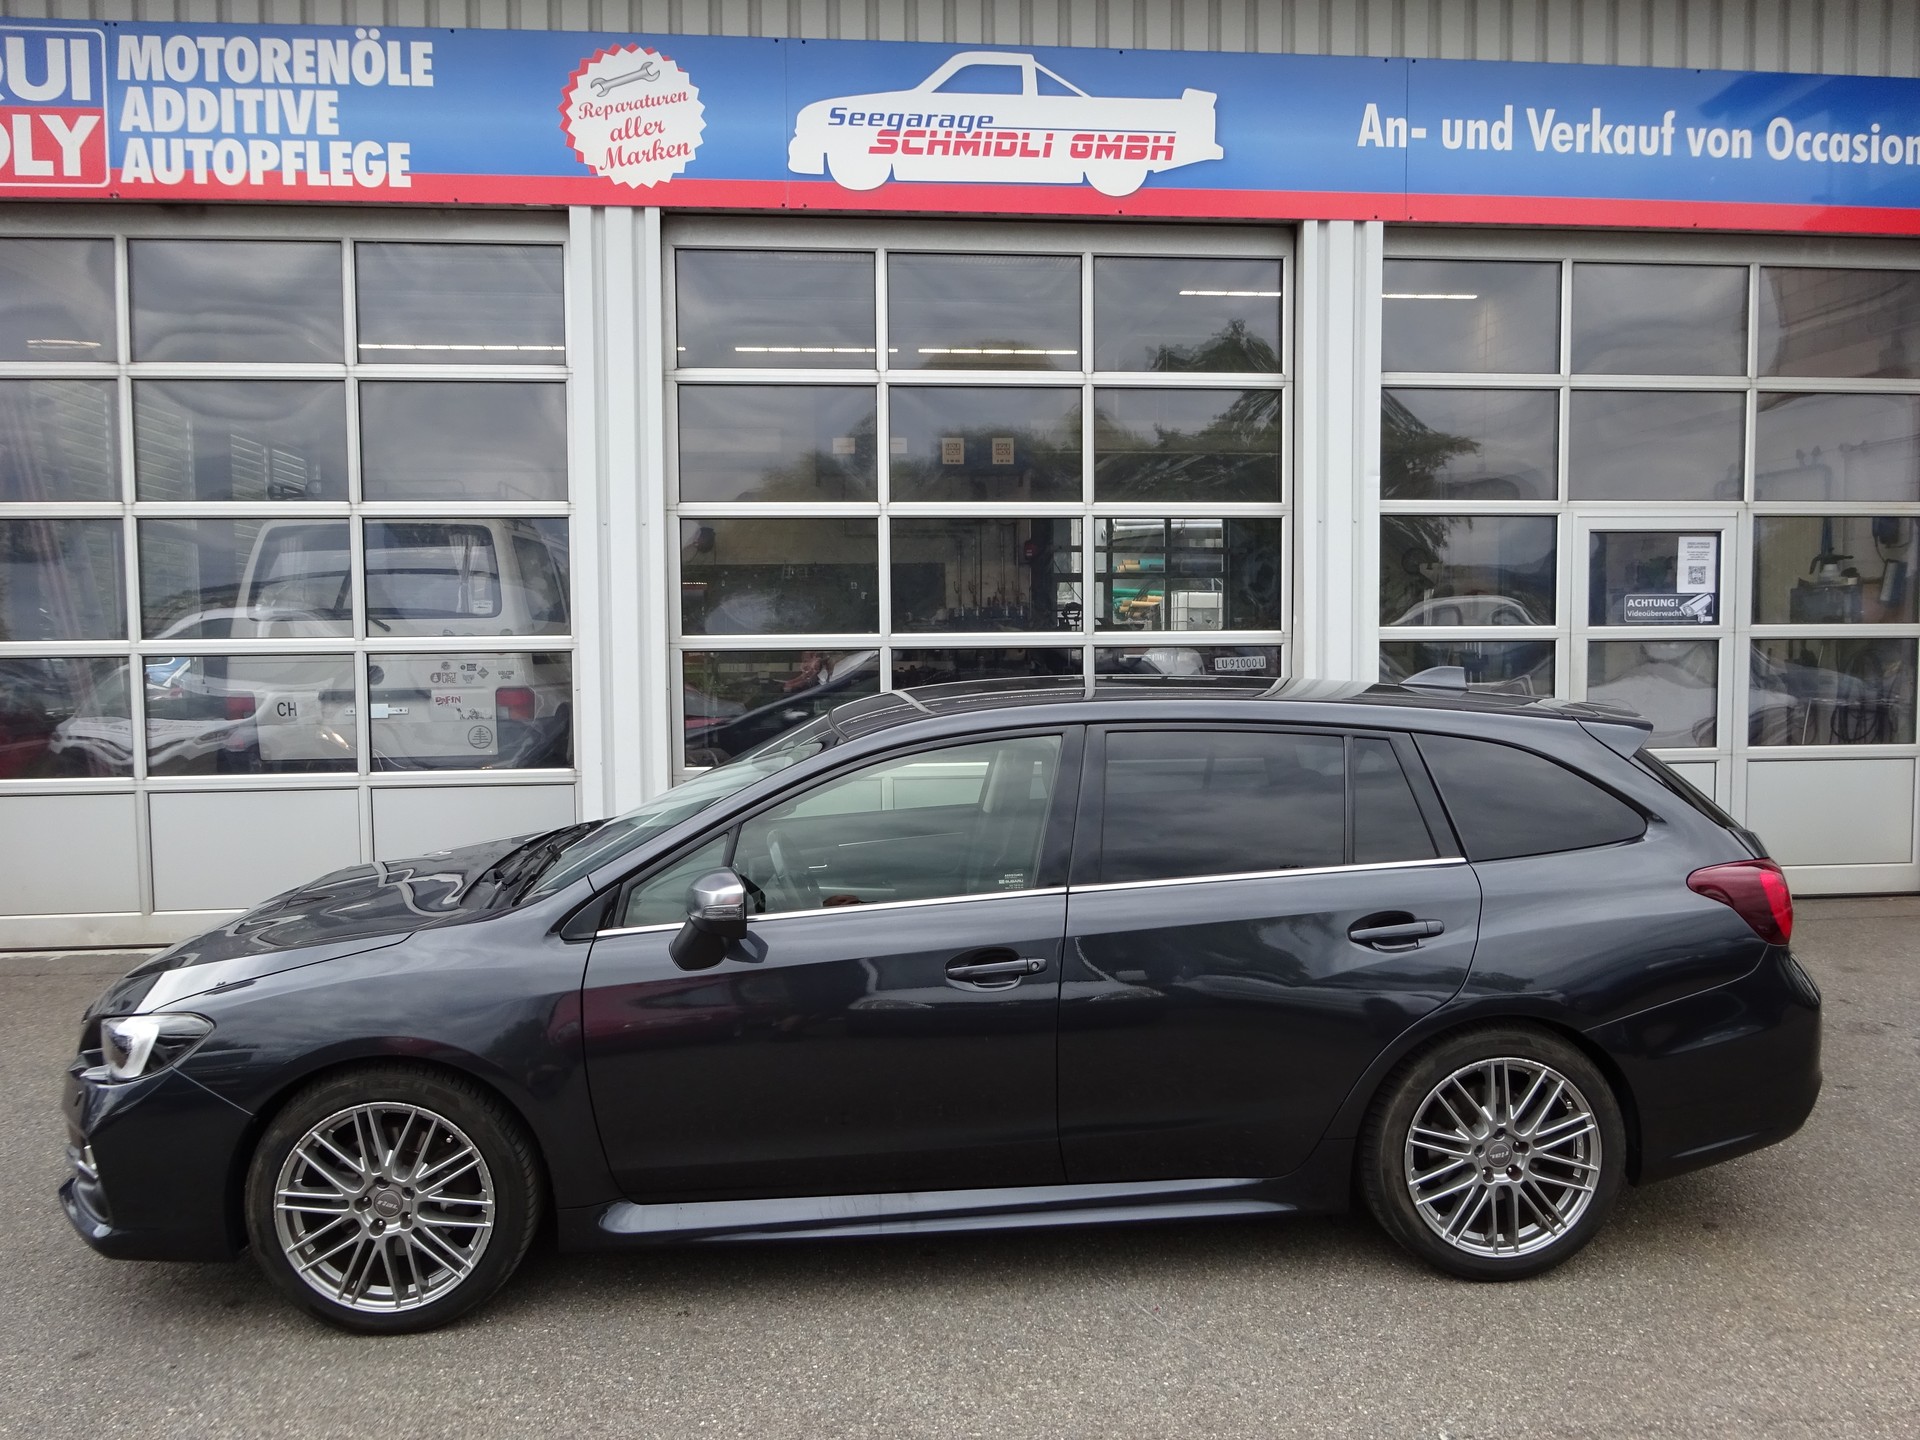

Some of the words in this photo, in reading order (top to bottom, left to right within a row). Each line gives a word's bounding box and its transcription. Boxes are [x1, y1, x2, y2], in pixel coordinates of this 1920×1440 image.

[0, 36, 91, 102] UI
[117, 28, 434, 87] MOTORENÖLE
[119, 86, 340, 136] ADDITIVE
[578, 90, 689, 120] Reparaturen
[828, 107, 994, 134] Seegarage
[610, 115, 666, 142] aller
[1357, 102, 1427, 148] An-
[1441, 104, 1514, 151] und
[1526, 107, 1676, 157] Verkauf
[1686, 126, 1753, 159] von
[0, 113, 101, 177] LY
[599, 138, 692, 170] Marken
[868, 129, 1054, 159] SCHMIDLI
[1070, 133, 1176, 161] GMBH
[120, 137, 412, 188] AUTOPFLEGE
[1627, 598, 1679, 608] ACHTUNG!
[1627, 610, 1682, 618] Videoüberwacht
[276, 701, 297, 717] CH
